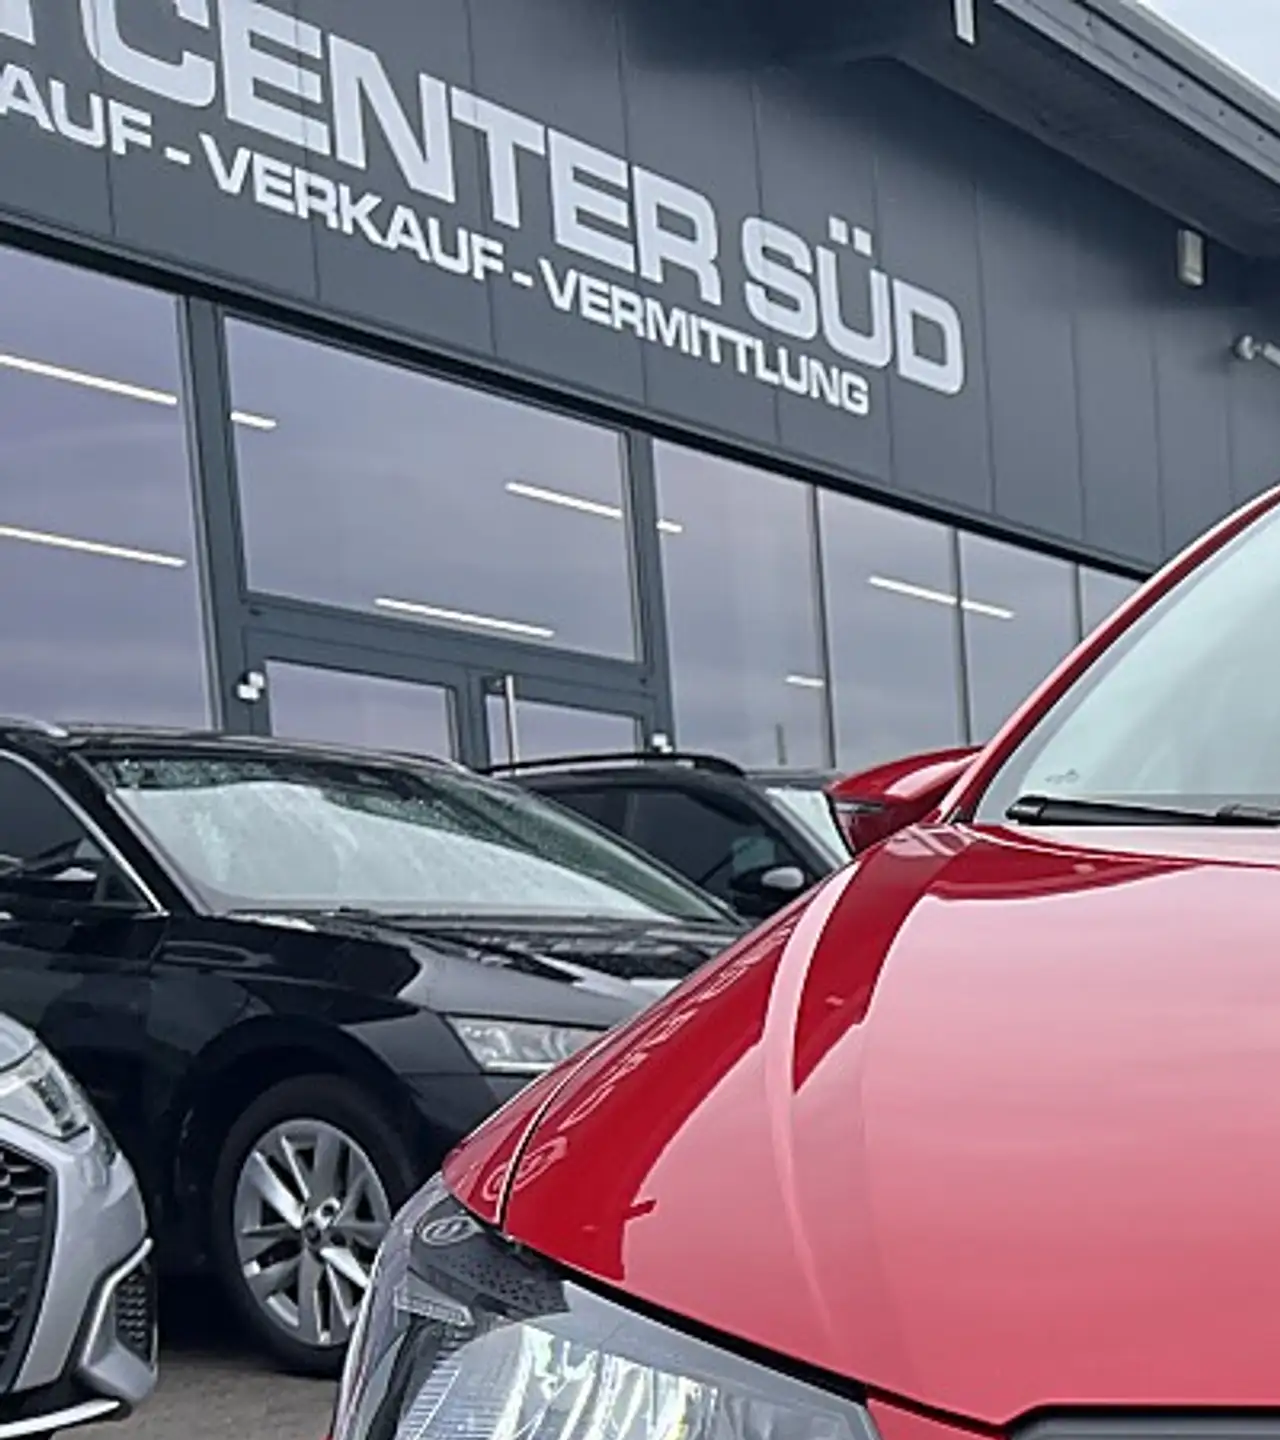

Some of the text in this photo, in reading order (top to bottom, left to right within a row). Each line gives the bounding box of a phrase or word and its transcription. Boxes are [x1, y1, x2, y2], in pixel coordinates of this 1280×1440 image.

[199, 131, 504, 281] VERKAUF
[538, 257, 870, 416] VERMITTLUNG
[741, 215, 965, 395] SÜD
